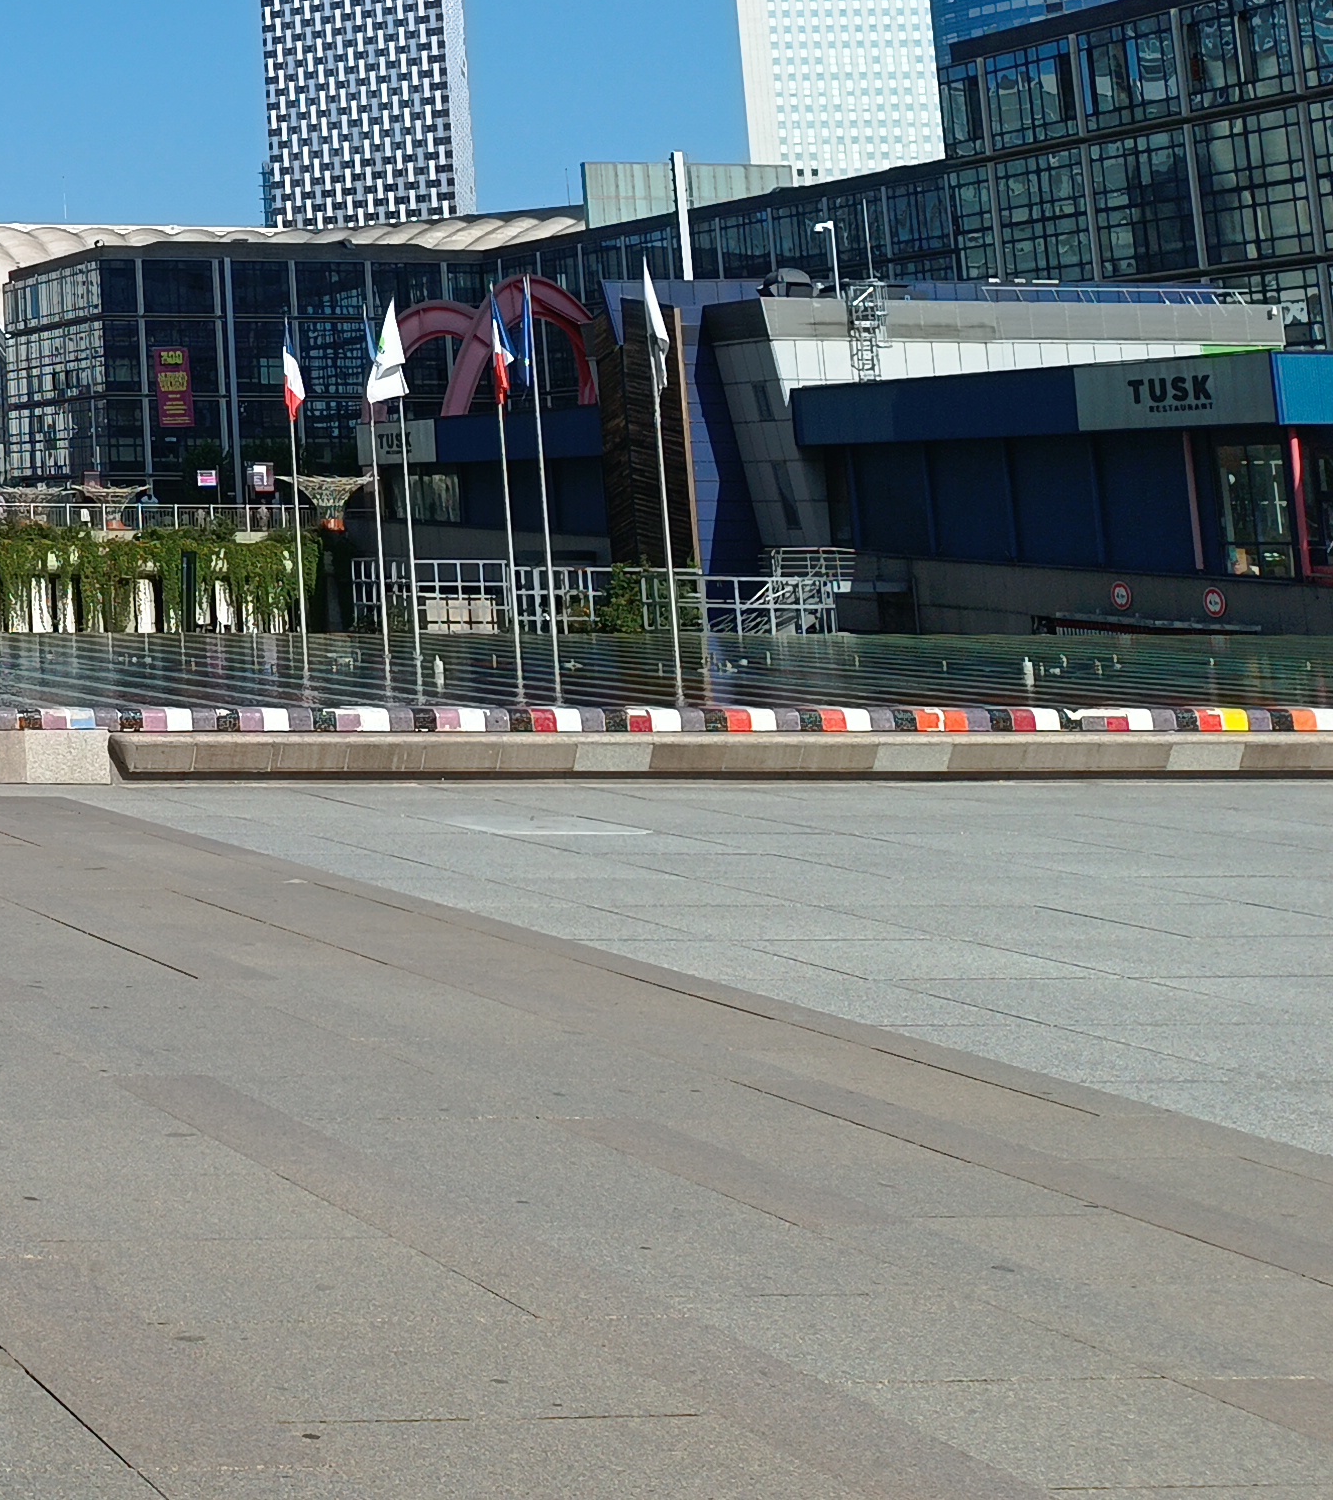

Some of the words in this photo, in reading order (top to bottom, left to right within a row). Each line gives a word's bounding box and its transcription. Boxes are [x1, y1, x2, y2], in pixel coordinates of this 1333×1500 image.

[1127, 374, 1212, 404] TUSK
[1149, 402, 1213, 413] RESTAURANT
[377, 431, 412, 449] TUSK
